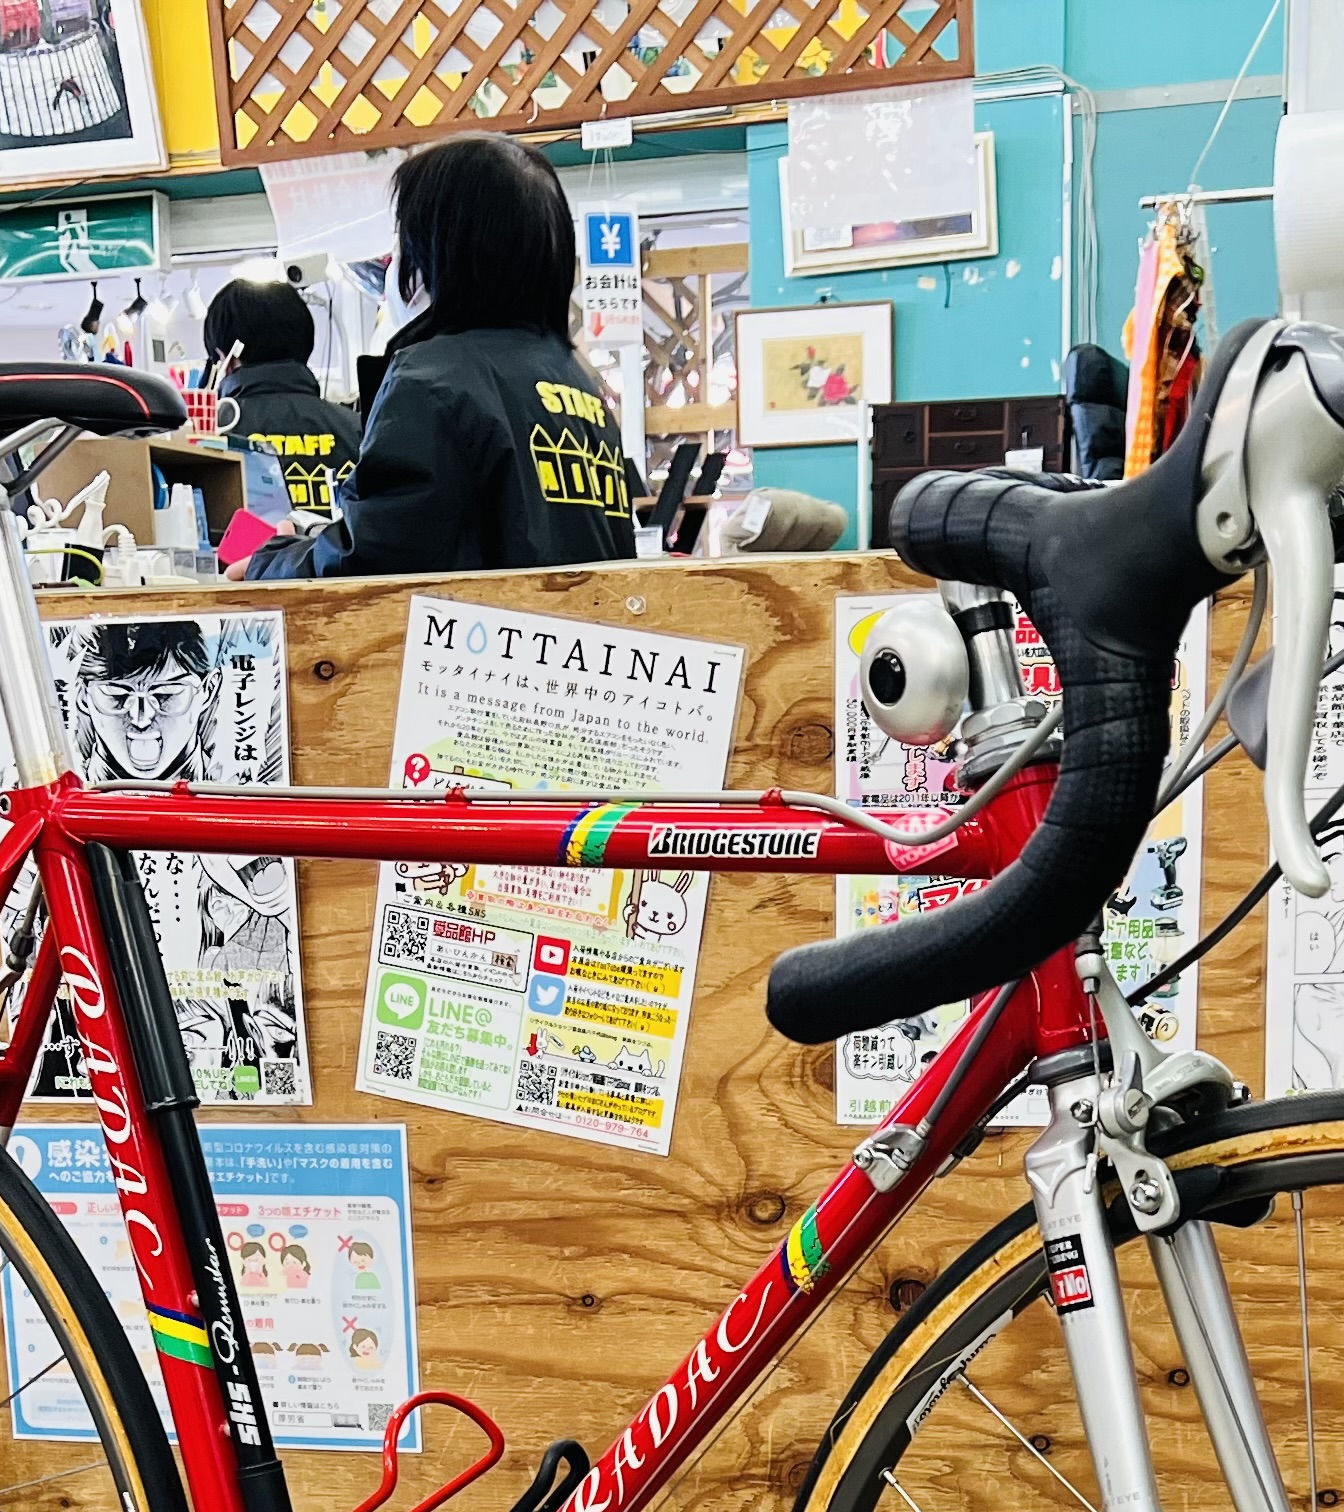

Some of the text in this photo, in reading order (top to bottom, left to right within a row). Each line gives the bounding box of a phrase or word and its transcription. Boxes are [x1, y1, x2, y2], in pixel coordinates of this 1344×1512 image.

[585, 274, 637, 290] お会計は
[586, 298, 639, 310] こちらです
[535, 381, 606, 428] STAFF
[248, 434, 335, 456] STAFF
[420, 660, 715, 723] モッタイナイは、世界中のアイコトバ。
[229, 653, 260, 763] 電子レンジは
[417, 681, 428, 697] It
[435, 685, 447, 699] is
[454, 691, 461, 702] a
[467, 693, 527, 713] message
[533, 700, 565, 719] from
[571, 707, 610, 730] Japan
[617, 717, 632, 730] to
[636, 720, 659, 736] the
[650, 826, 818, 857] BRIDGESTONE
[433, 919, 496, 945] 愛品館HP
[389, 992, 414, 1007] LINE
[427, 997, 493, 1028] LINE@
[425, 1018, 514, 1052] 友だち募集中。
[60, 945, 164, 1293] RADAC
[47, 1138, 113, 1169] 感染
